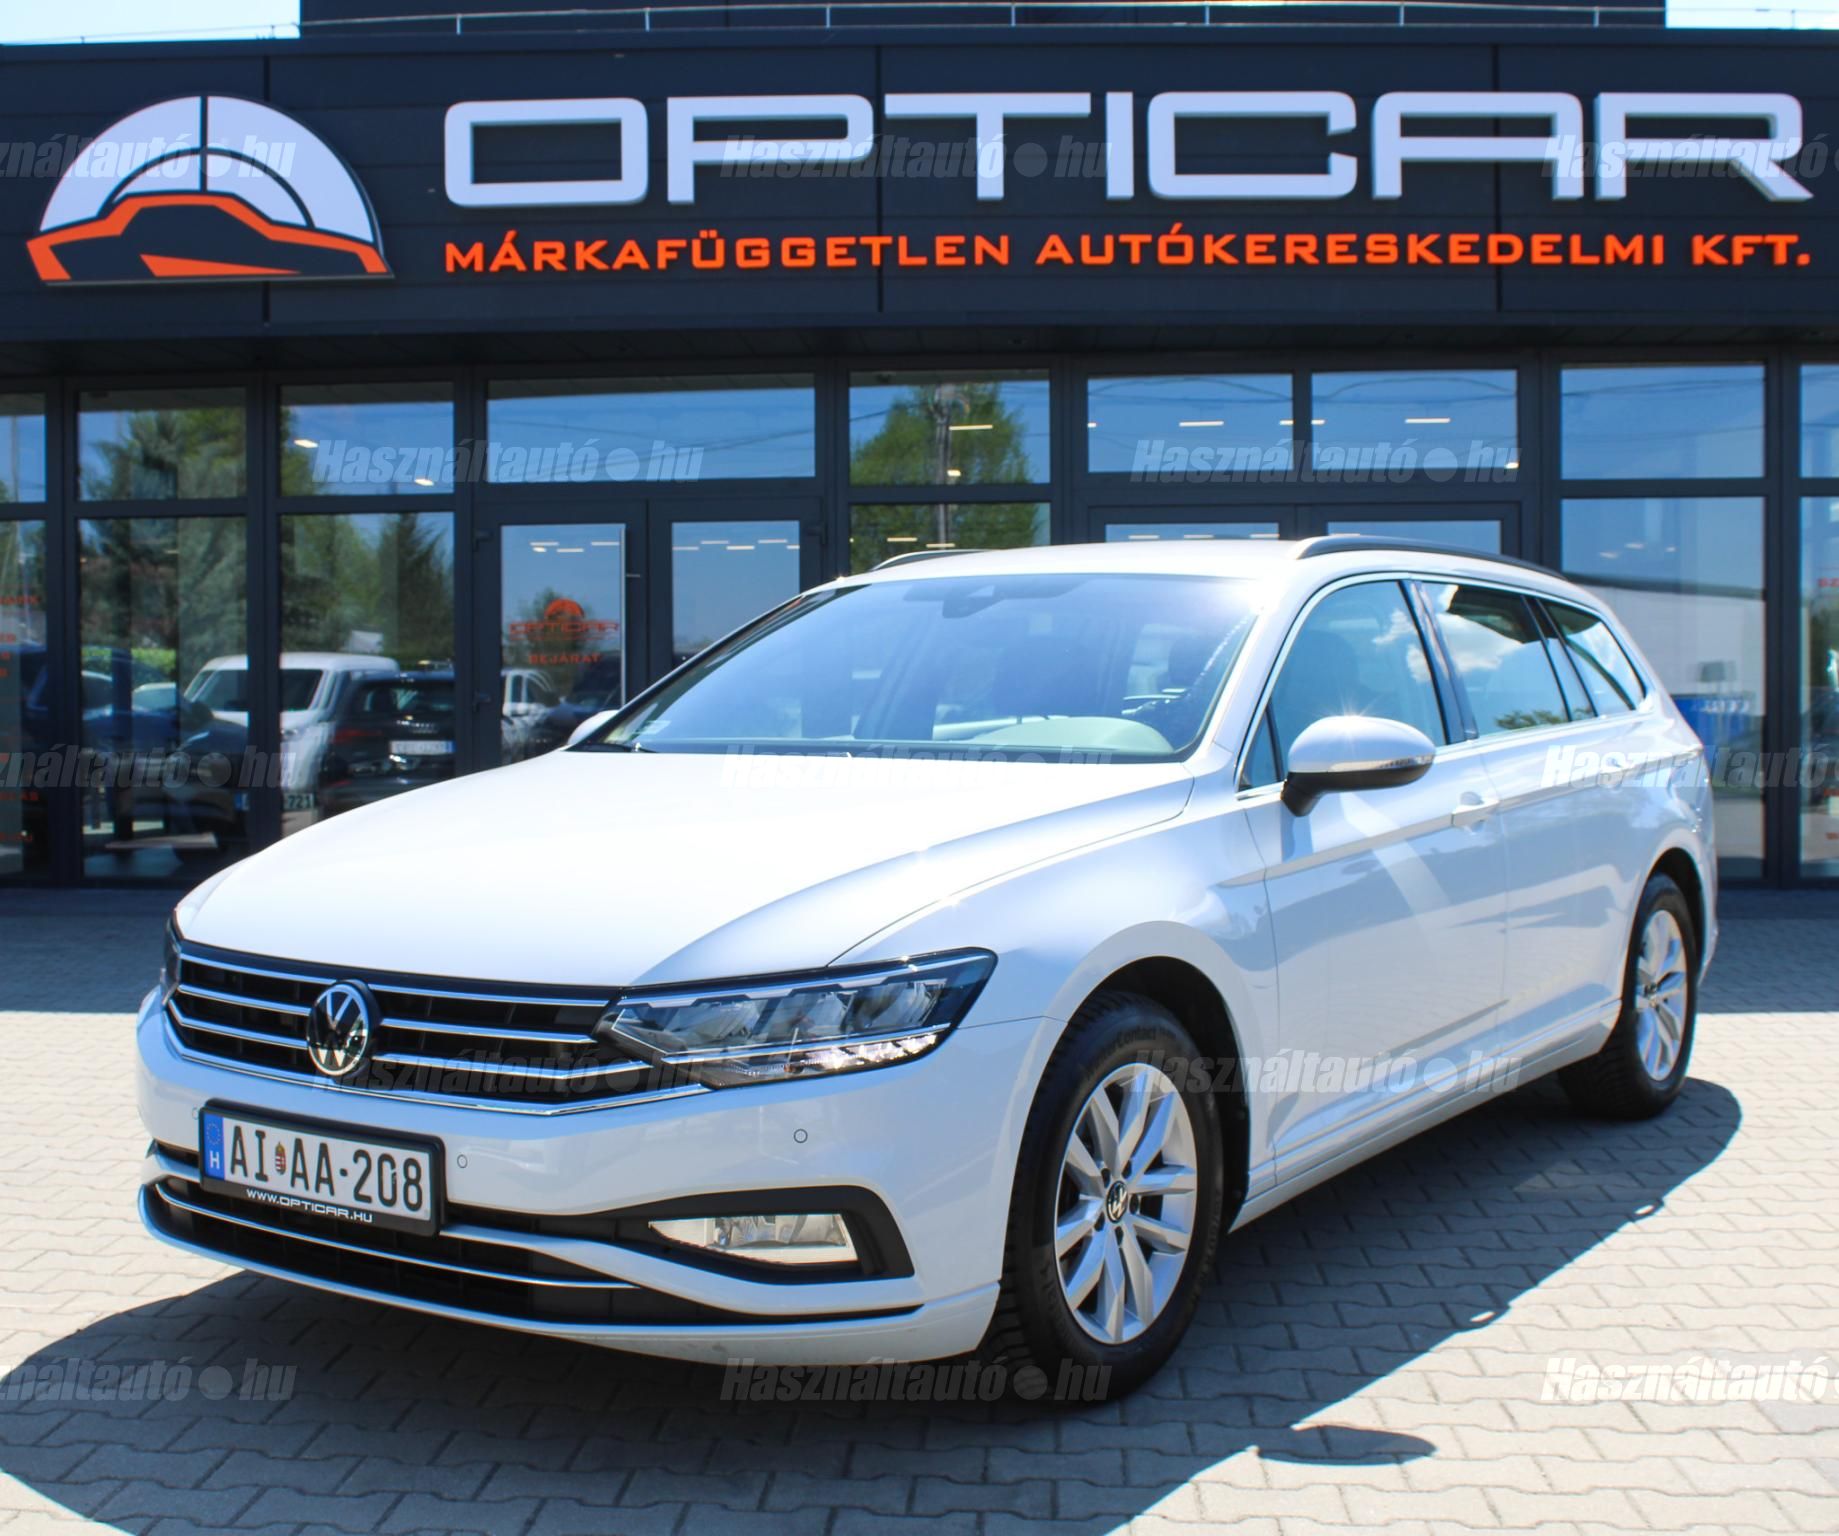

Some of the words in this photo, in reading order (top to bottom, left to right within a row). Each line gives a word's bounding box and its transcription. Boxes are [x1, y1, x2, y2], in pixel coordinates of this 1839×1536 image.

[444, 91, 1813, 207] OPTICAR
[445, 229, 1009, 273] MÁRKAFÜGGETLEN
[1035, 222, 1665, 265] AUTÓKERESKEDELMI
[1692, 233, 1811, 266] KFT.
[208, 1149, 221, 1170] H
